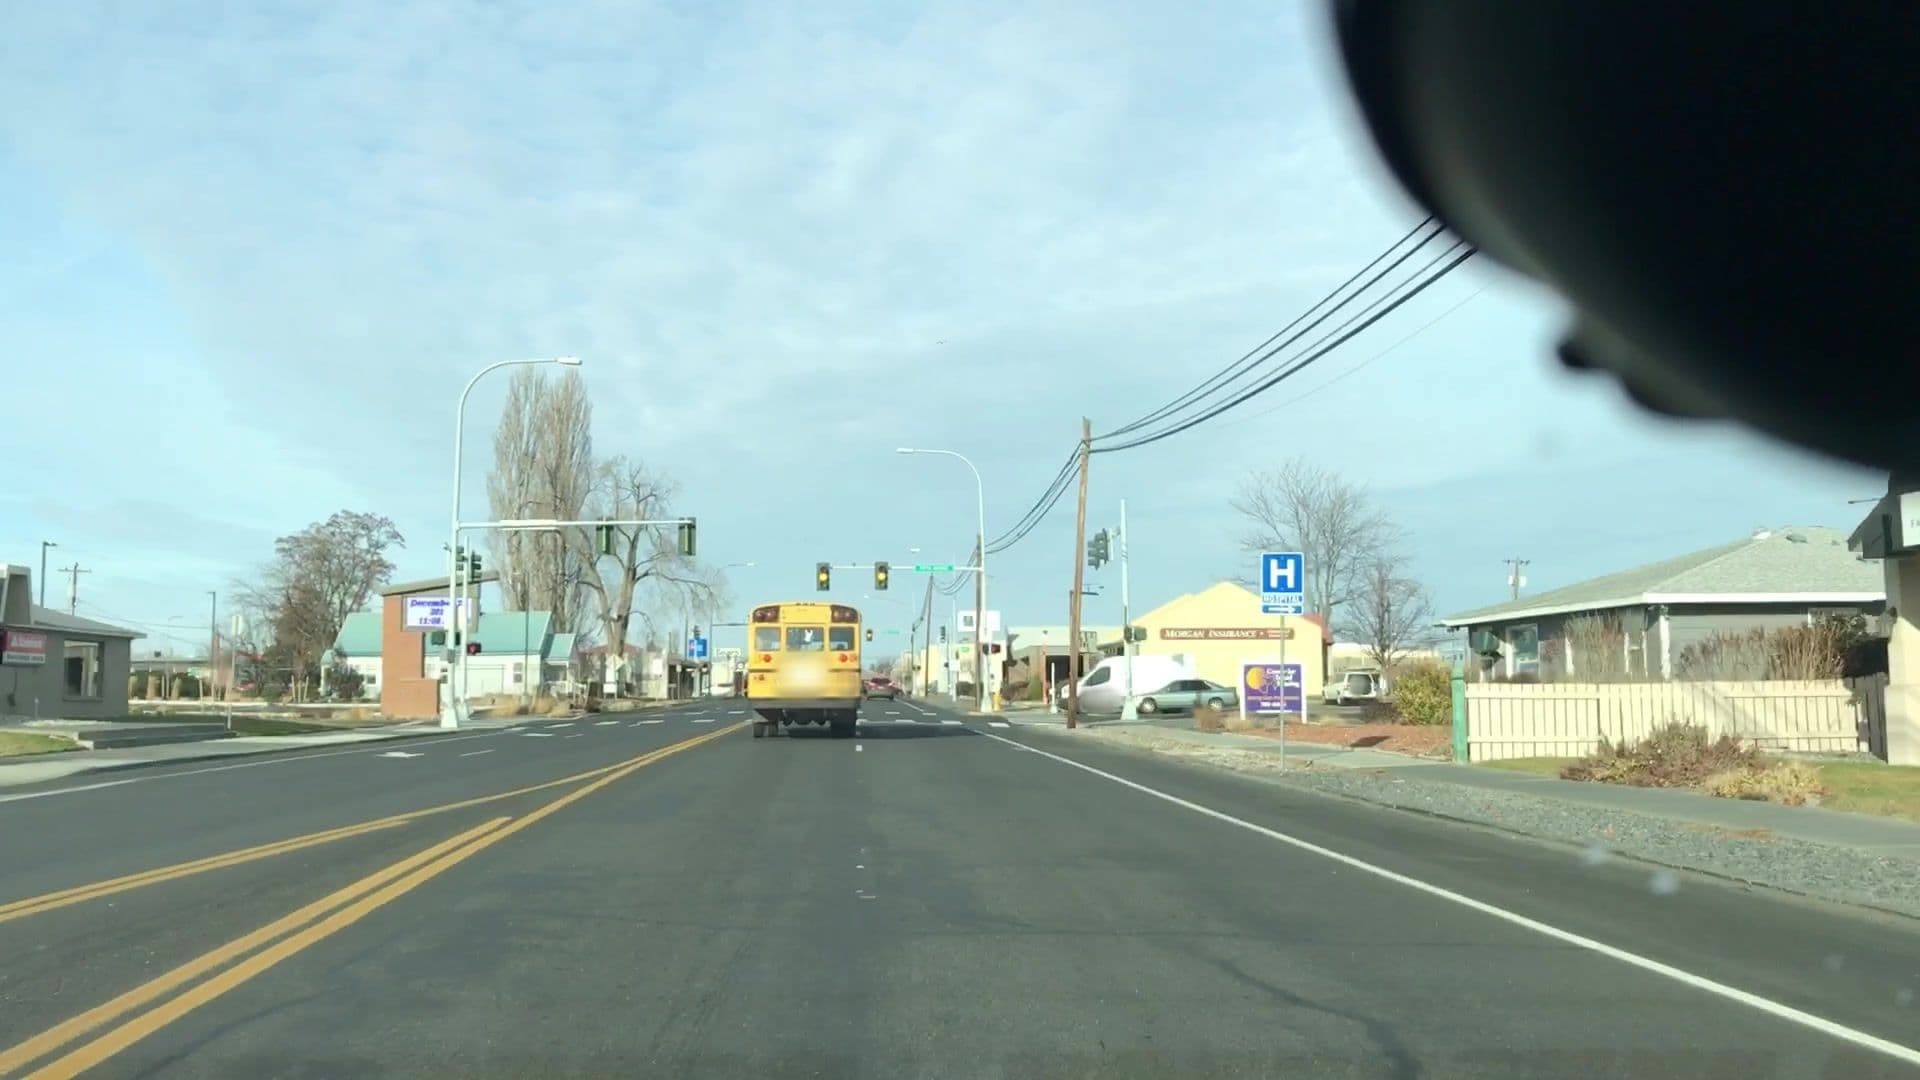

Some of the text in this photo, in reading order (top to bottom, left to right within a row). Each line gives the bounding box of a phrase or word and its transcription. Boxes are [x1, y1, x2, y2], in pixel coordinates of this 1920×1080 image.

[1270, 559, 1295, 588] H
[410, 599, 450, 607] Decembe
[1263, 595, 1300, 603] HOSPITAL
[1208, 629, 1257, 639] INSURANCE
